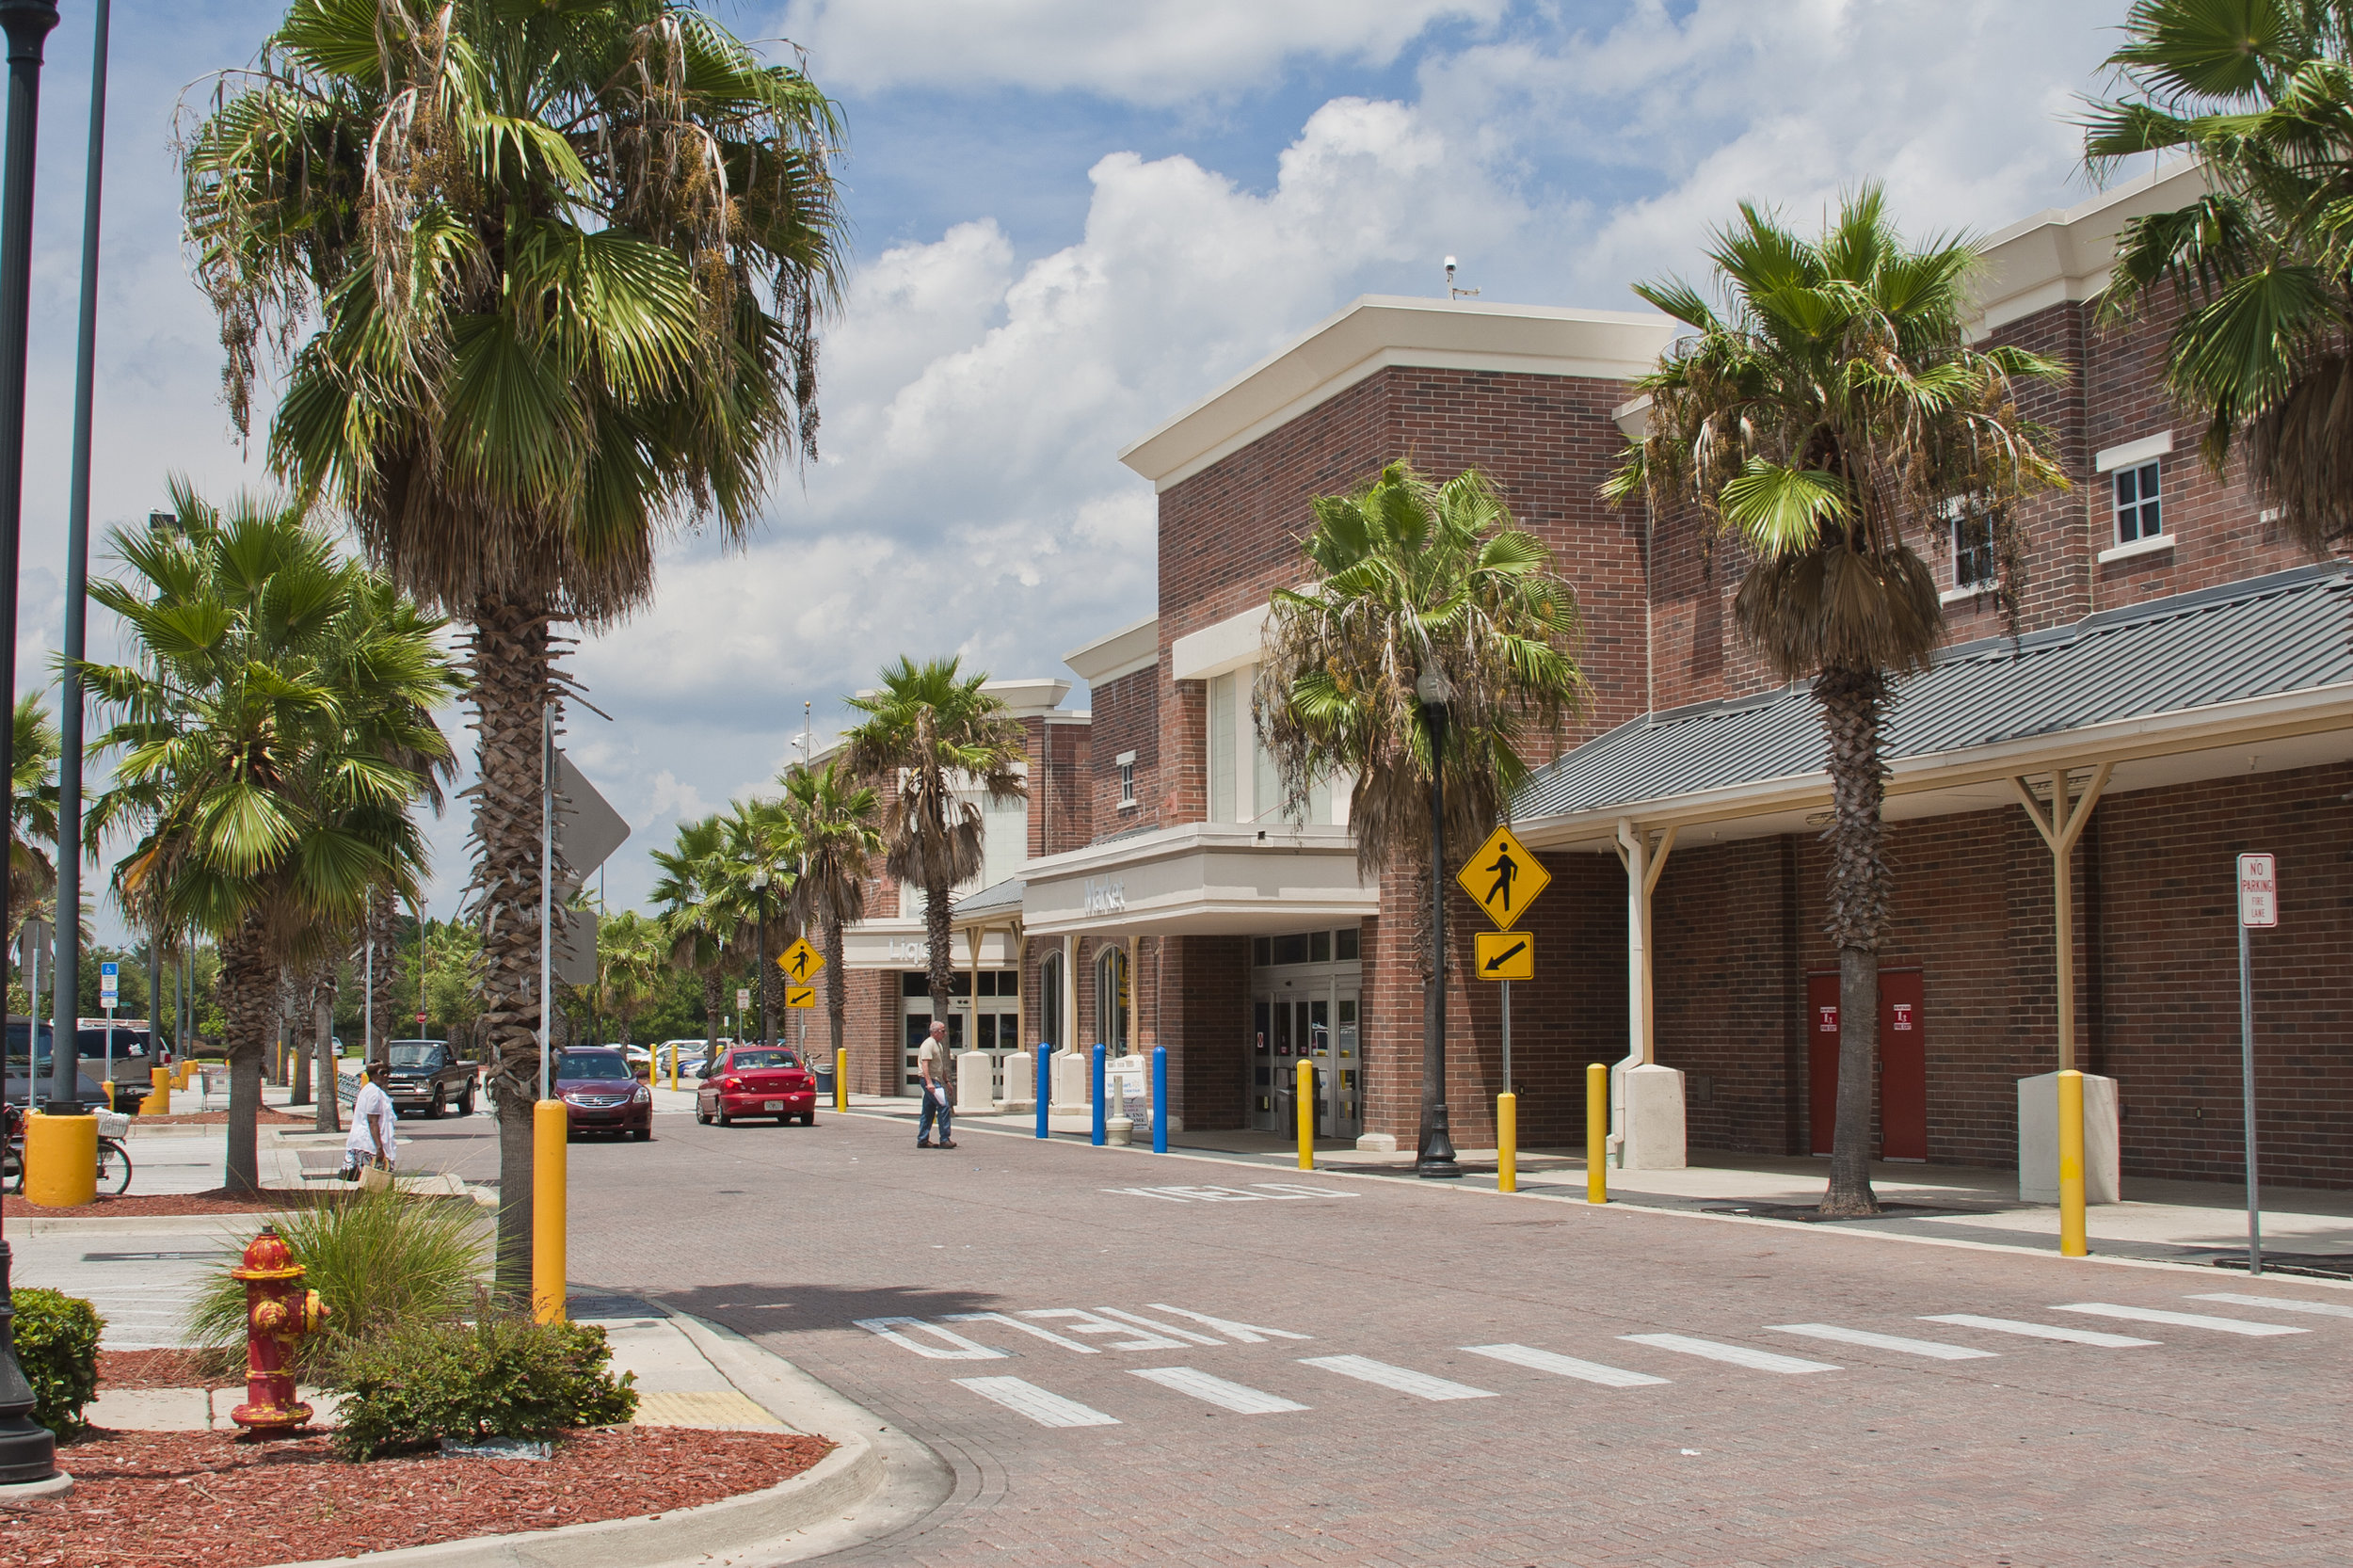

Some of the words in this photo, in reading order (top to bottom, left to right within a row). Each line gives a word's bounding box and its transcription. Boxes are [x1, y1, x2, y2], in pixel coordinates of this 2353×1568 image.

[2250, 862, 2263, 875] NO
[1084, 873, 1125, 912] Market
[2243, 880, 2272, 892] PARKING
[2252, 896, 2264, 905] FIRE
[2251, 908, 2265, 918] LANE
[888, 937, 932, 965] Liqu
[338, 1079, 360, 1092] SCHOO
[1096, 1183, 1362, 1203] YIELD
[852, 1303, 1314, 1360] YIELD
